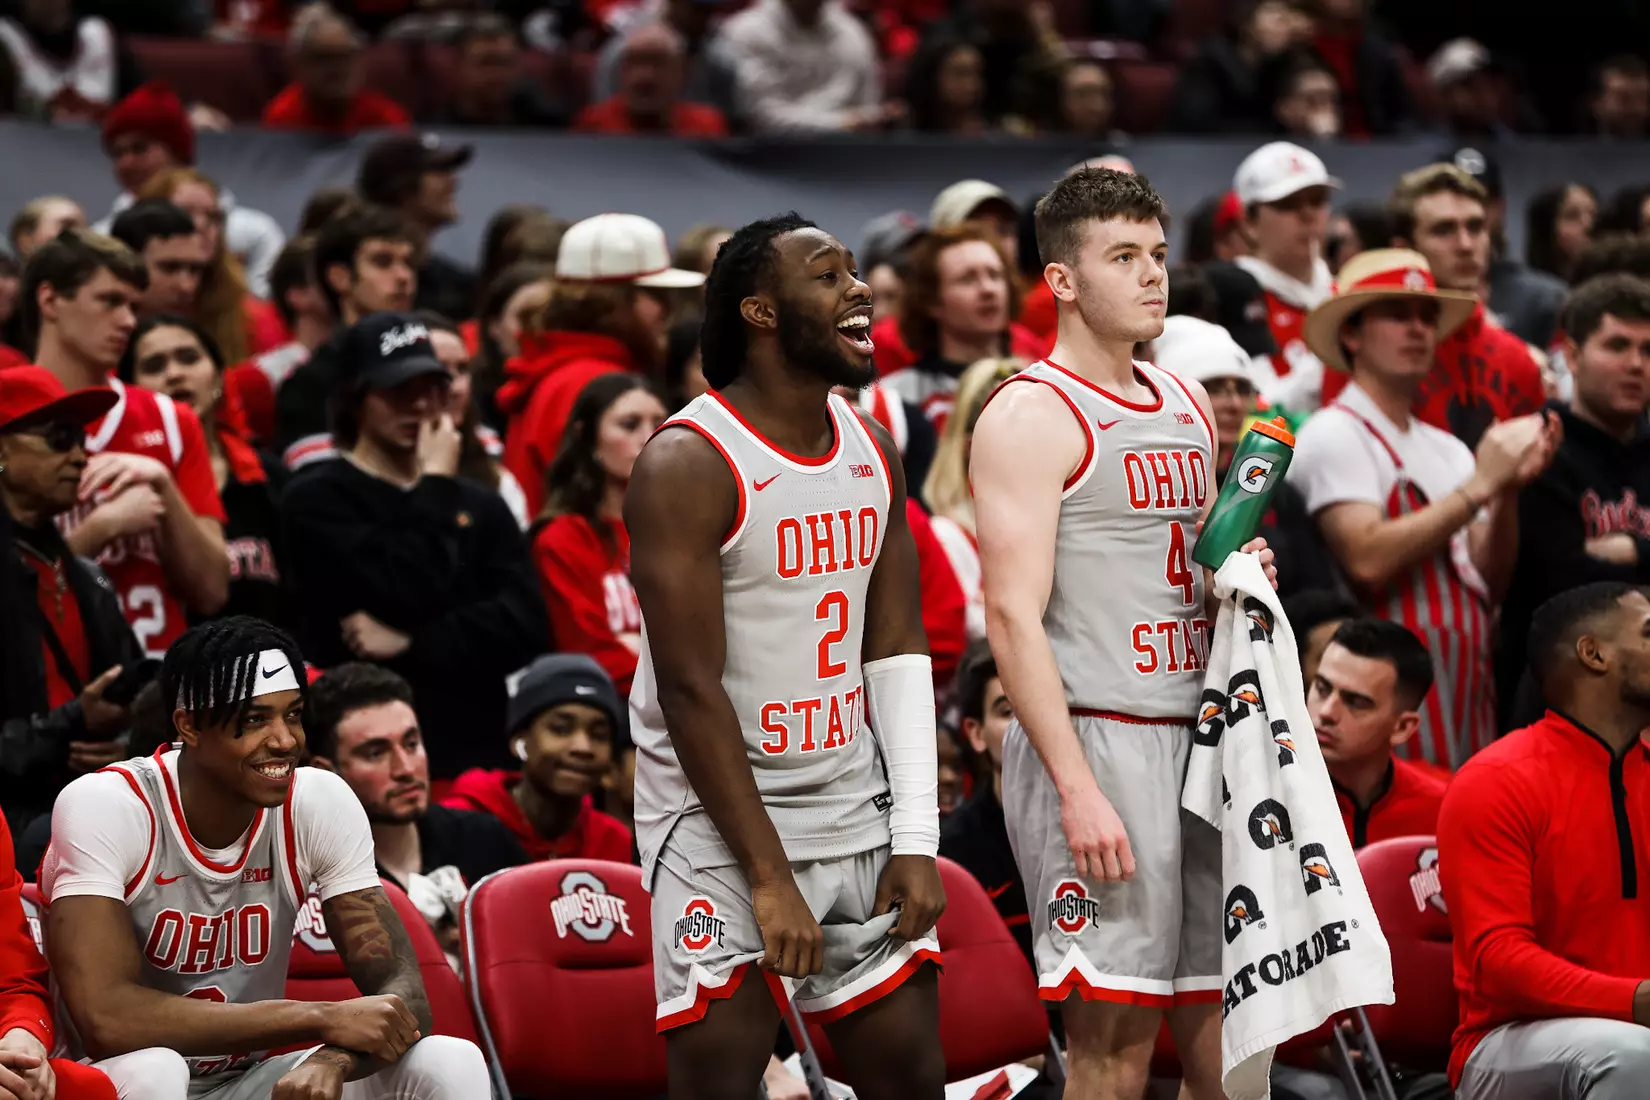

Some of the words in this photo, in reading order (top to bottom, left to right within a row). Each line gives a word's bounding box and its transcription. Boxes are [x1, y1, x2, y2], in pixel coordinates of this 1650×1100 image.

[1123, 449, 1207, 512] OHIO
[1237, 456, 1273, 494] G
[775, 505, 879, 580] OHIO
[1164, 520, 1195, 606] 4
[117, 585, 165, 660] 2
[814, 588, 850, 682] 2
[1131, 618, 1211, 676] STAT
[143, 903, 271, 975] OHIO
[1222, 920, 1351, 1012] ATORADE
